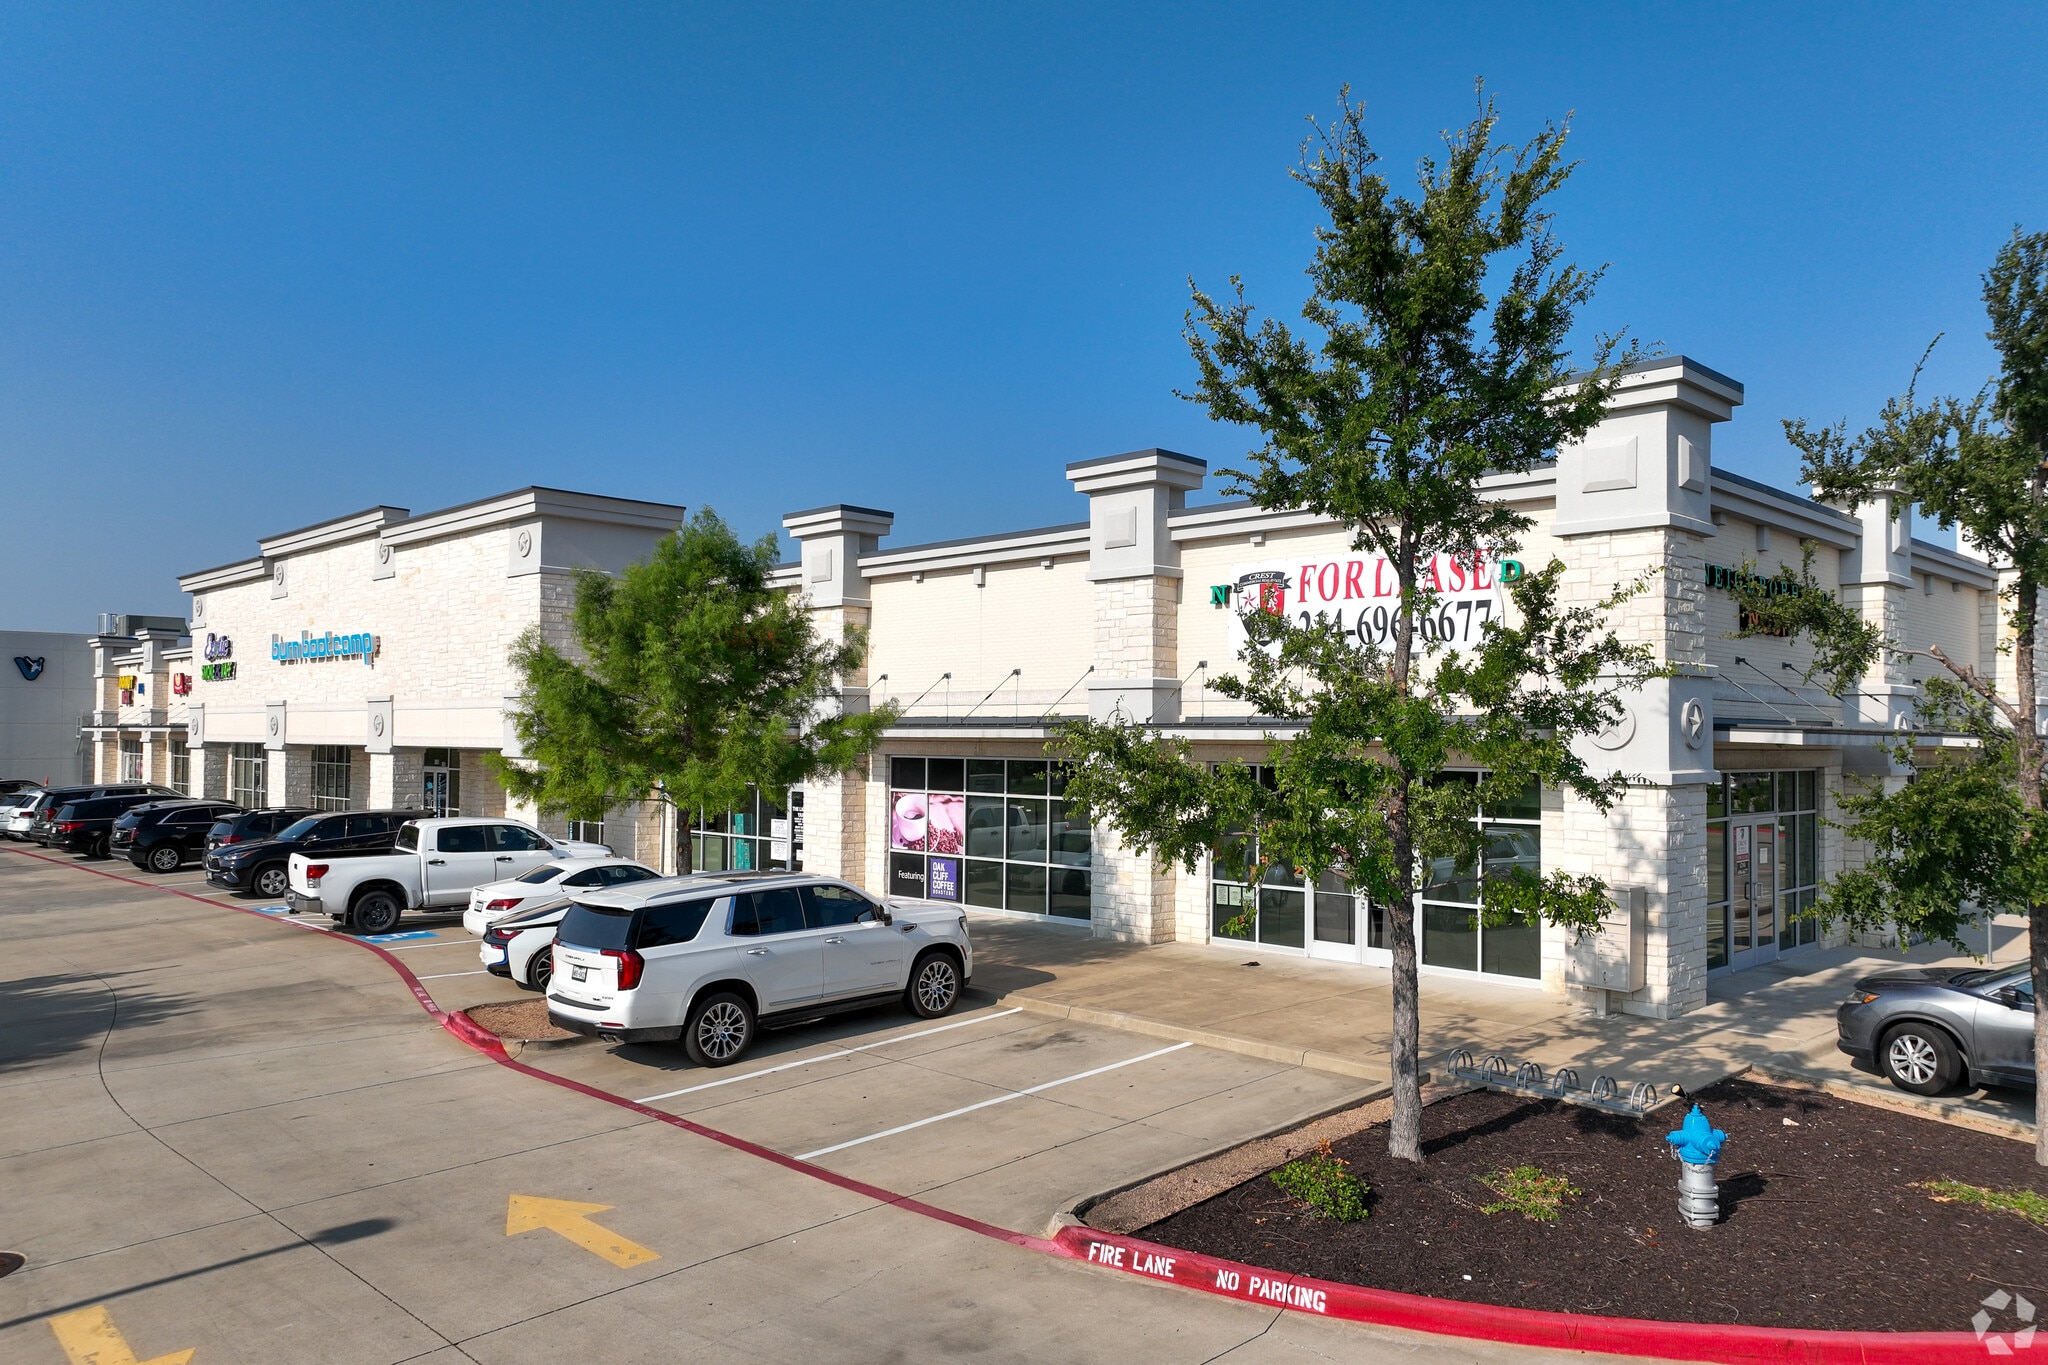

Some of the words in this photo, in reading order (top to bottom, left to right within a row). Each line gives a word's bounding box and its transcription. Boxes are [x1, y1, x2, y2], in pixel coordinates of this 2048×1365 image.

[1249, 572, 1276, 580] CREST
[1297, 560, 1365, 603] FOR
[1372, 547, 1492, 598] LASE
[272, 634, 300, 660] burn
[302, 630, 332, 658] boot
[333, 633, 372, 665] camp
[932, 862, 945, 871] OAK
[898, 870, 924, 882] Featuring
[932, 871, 949, 880] CLIFF
[932, 880, 955, 891] COFFEE
[1088, 1242, 1126, 1268] FIRE
[1132, 1250, 1176, 1278] LANE
[1216, 1269, 1239, 1291] NO
[1249, 1276, 1326, 1313] PARKING
